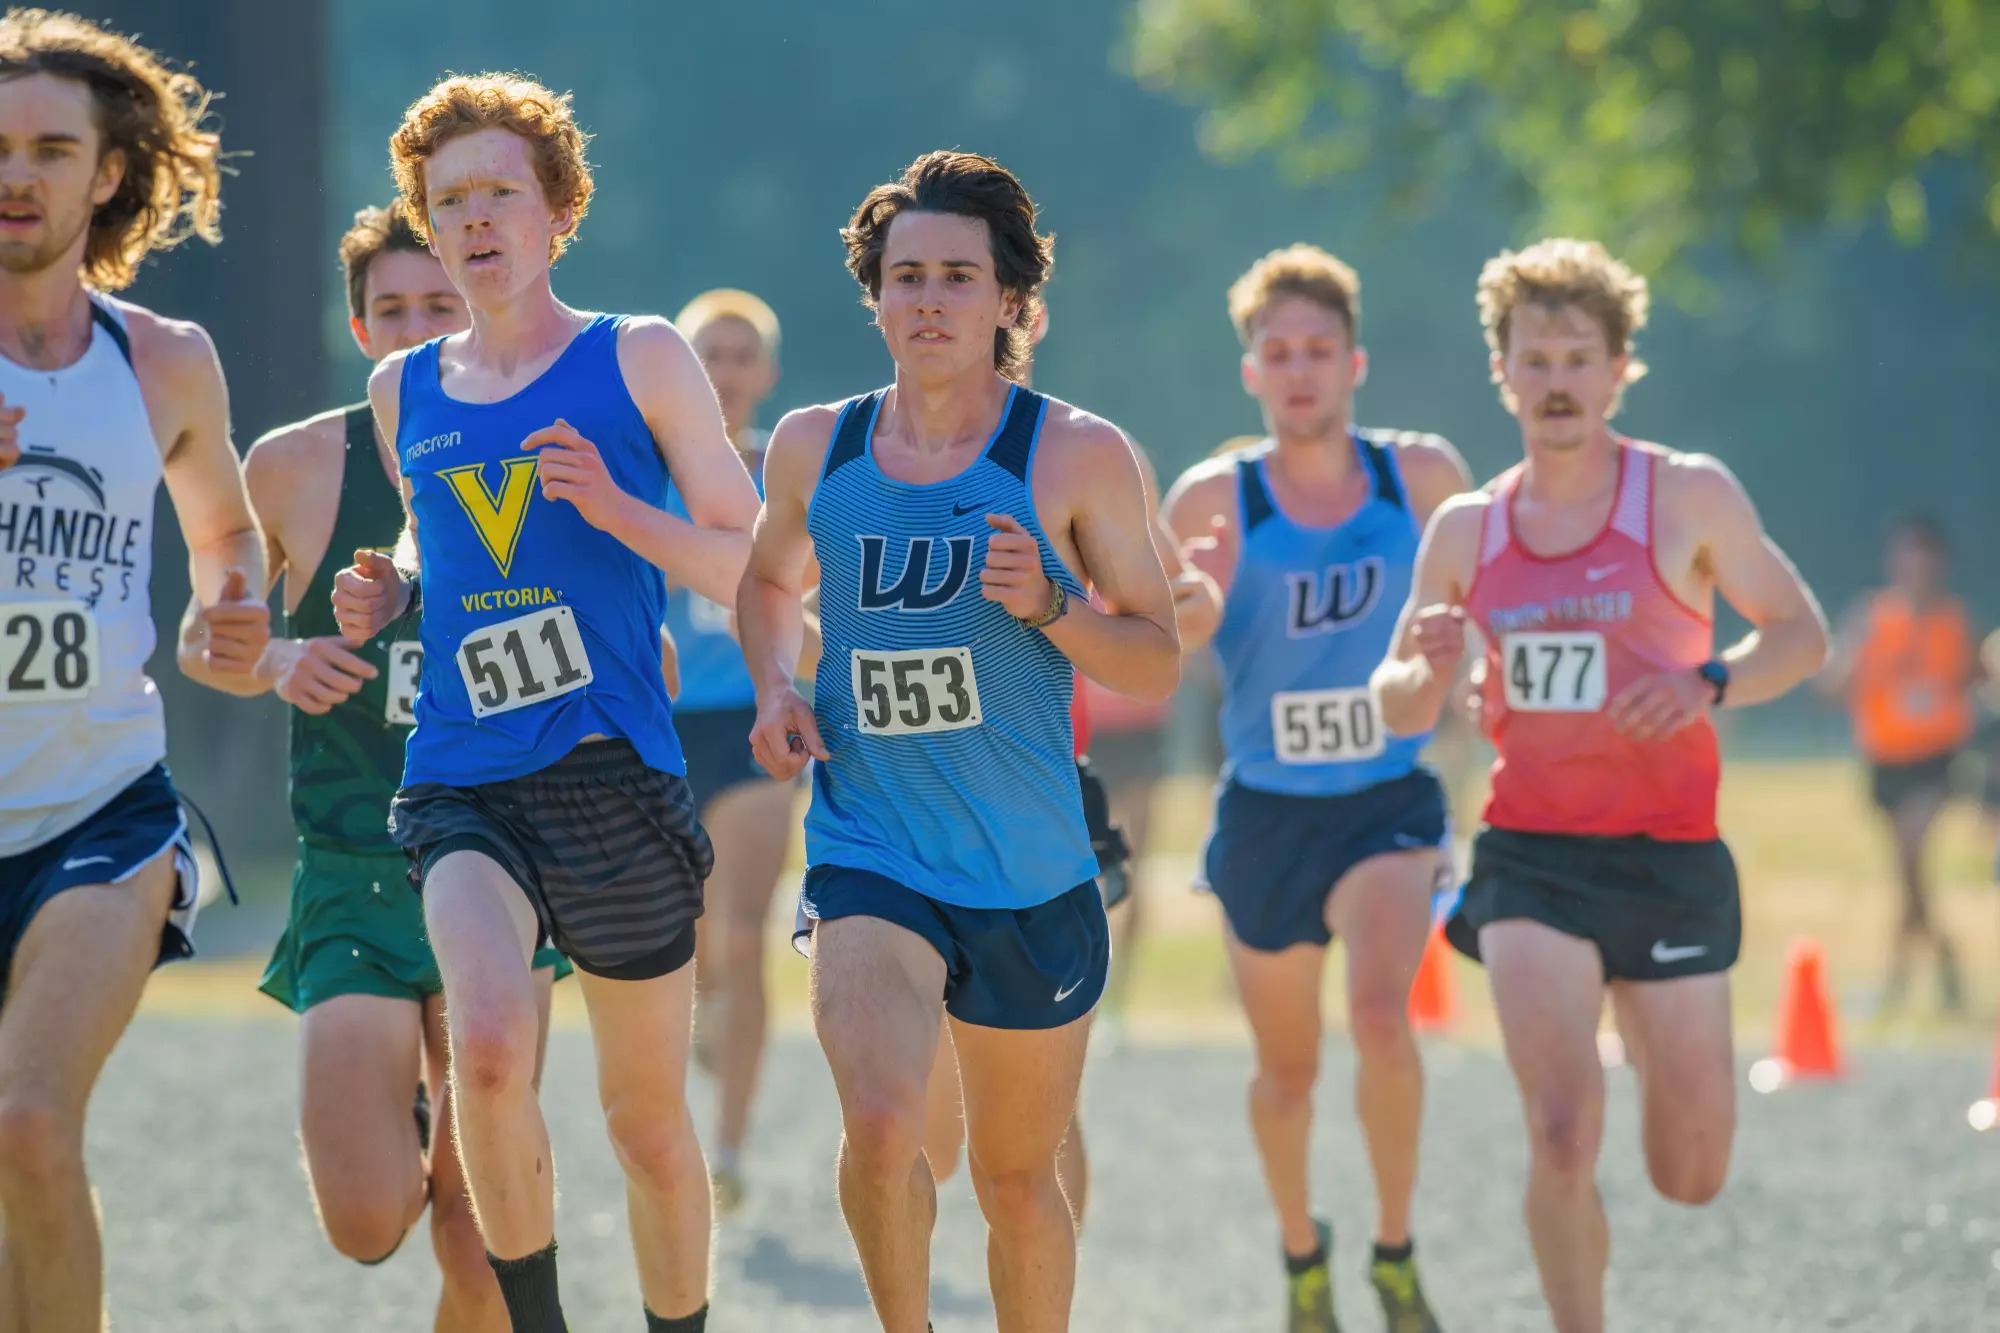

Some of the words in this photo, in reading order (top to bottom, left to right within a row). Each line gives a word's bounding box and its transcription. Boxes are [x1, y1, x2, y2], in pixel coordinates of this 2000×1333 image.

[406, 431, 461, 464] macron
[462, 587, 556, 612] VICTORIA
[6, 611, 89, 691] 28
[463, 618, 582, 708] 511
[1512, 643, 1595, 701] 477
[860, 656, 971, 728] 553
[1285, 697, 1374, 755] 550
